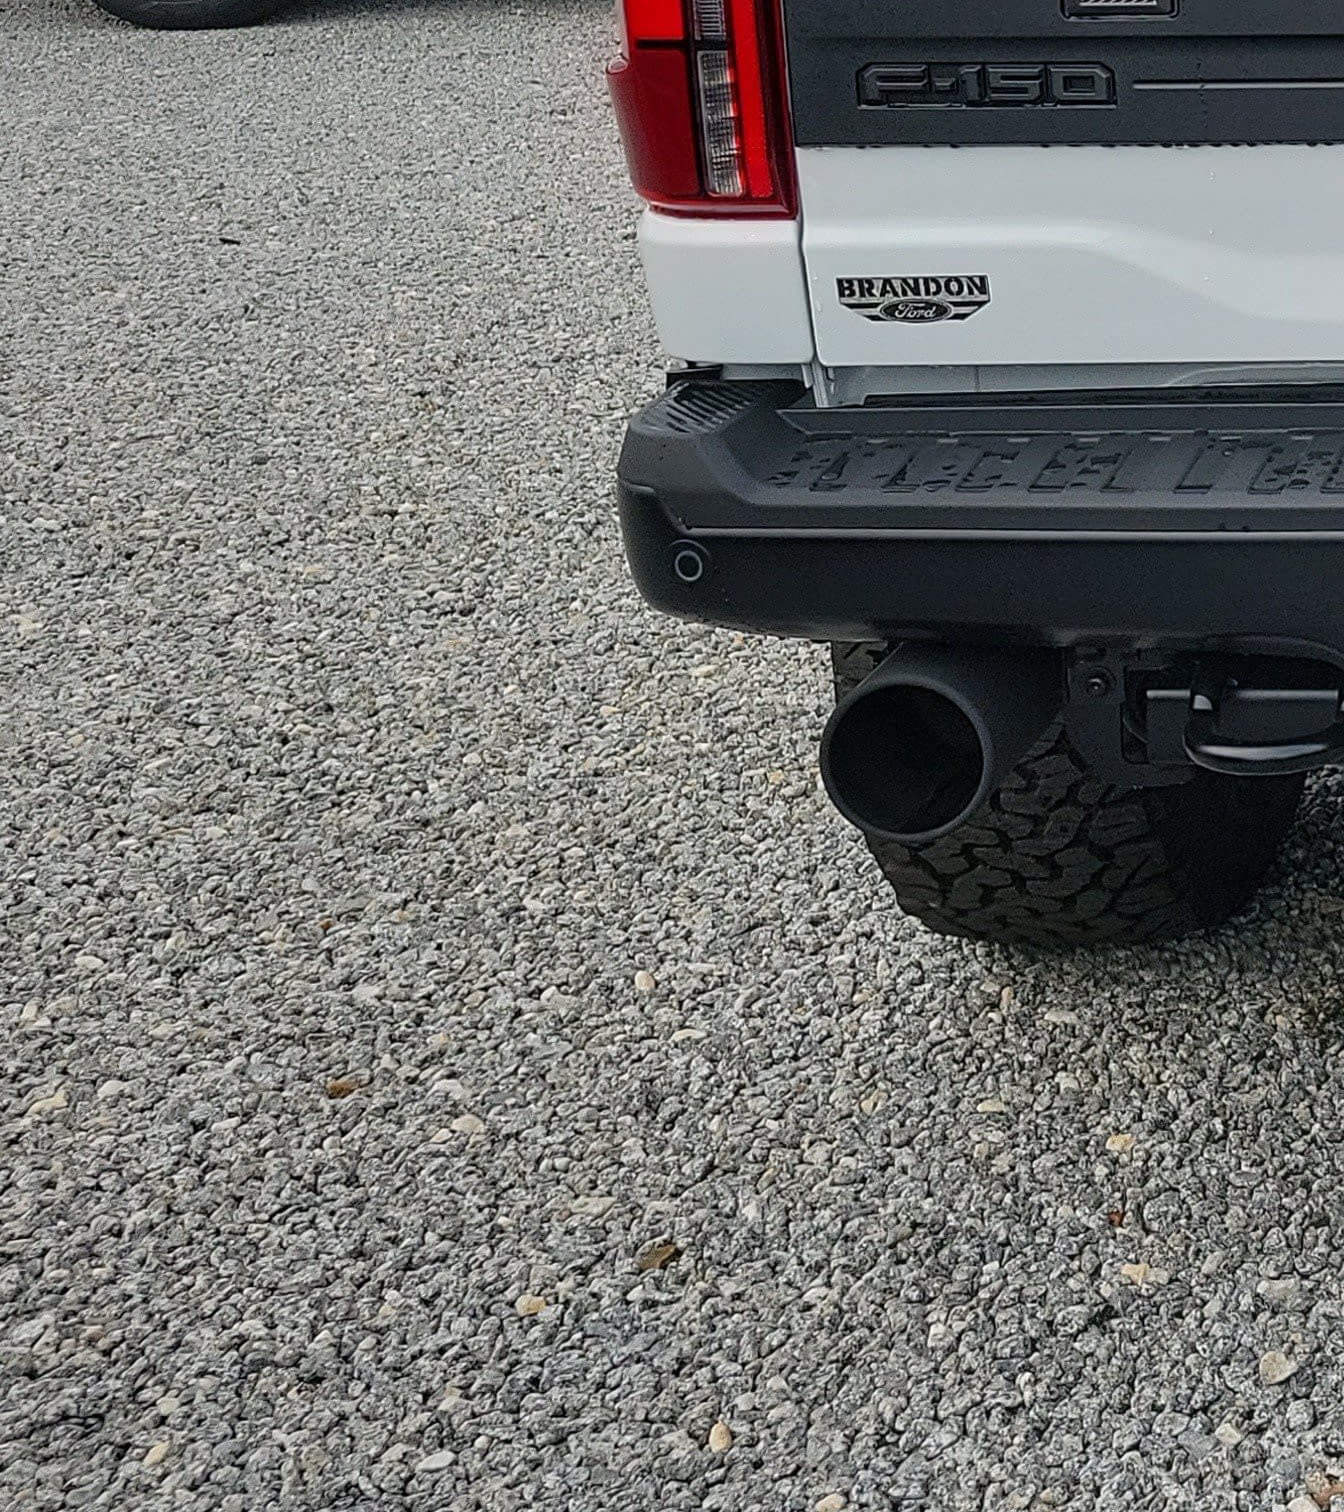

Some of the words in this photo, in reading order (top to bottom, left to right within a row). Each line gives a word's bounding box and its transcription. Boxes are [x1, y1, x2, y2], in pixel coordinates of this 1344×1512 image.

[856, 61, 1117, 108] F-150
[836, 275, 987, 298] BRANDON
[894, 302, 937, 319] Ford
